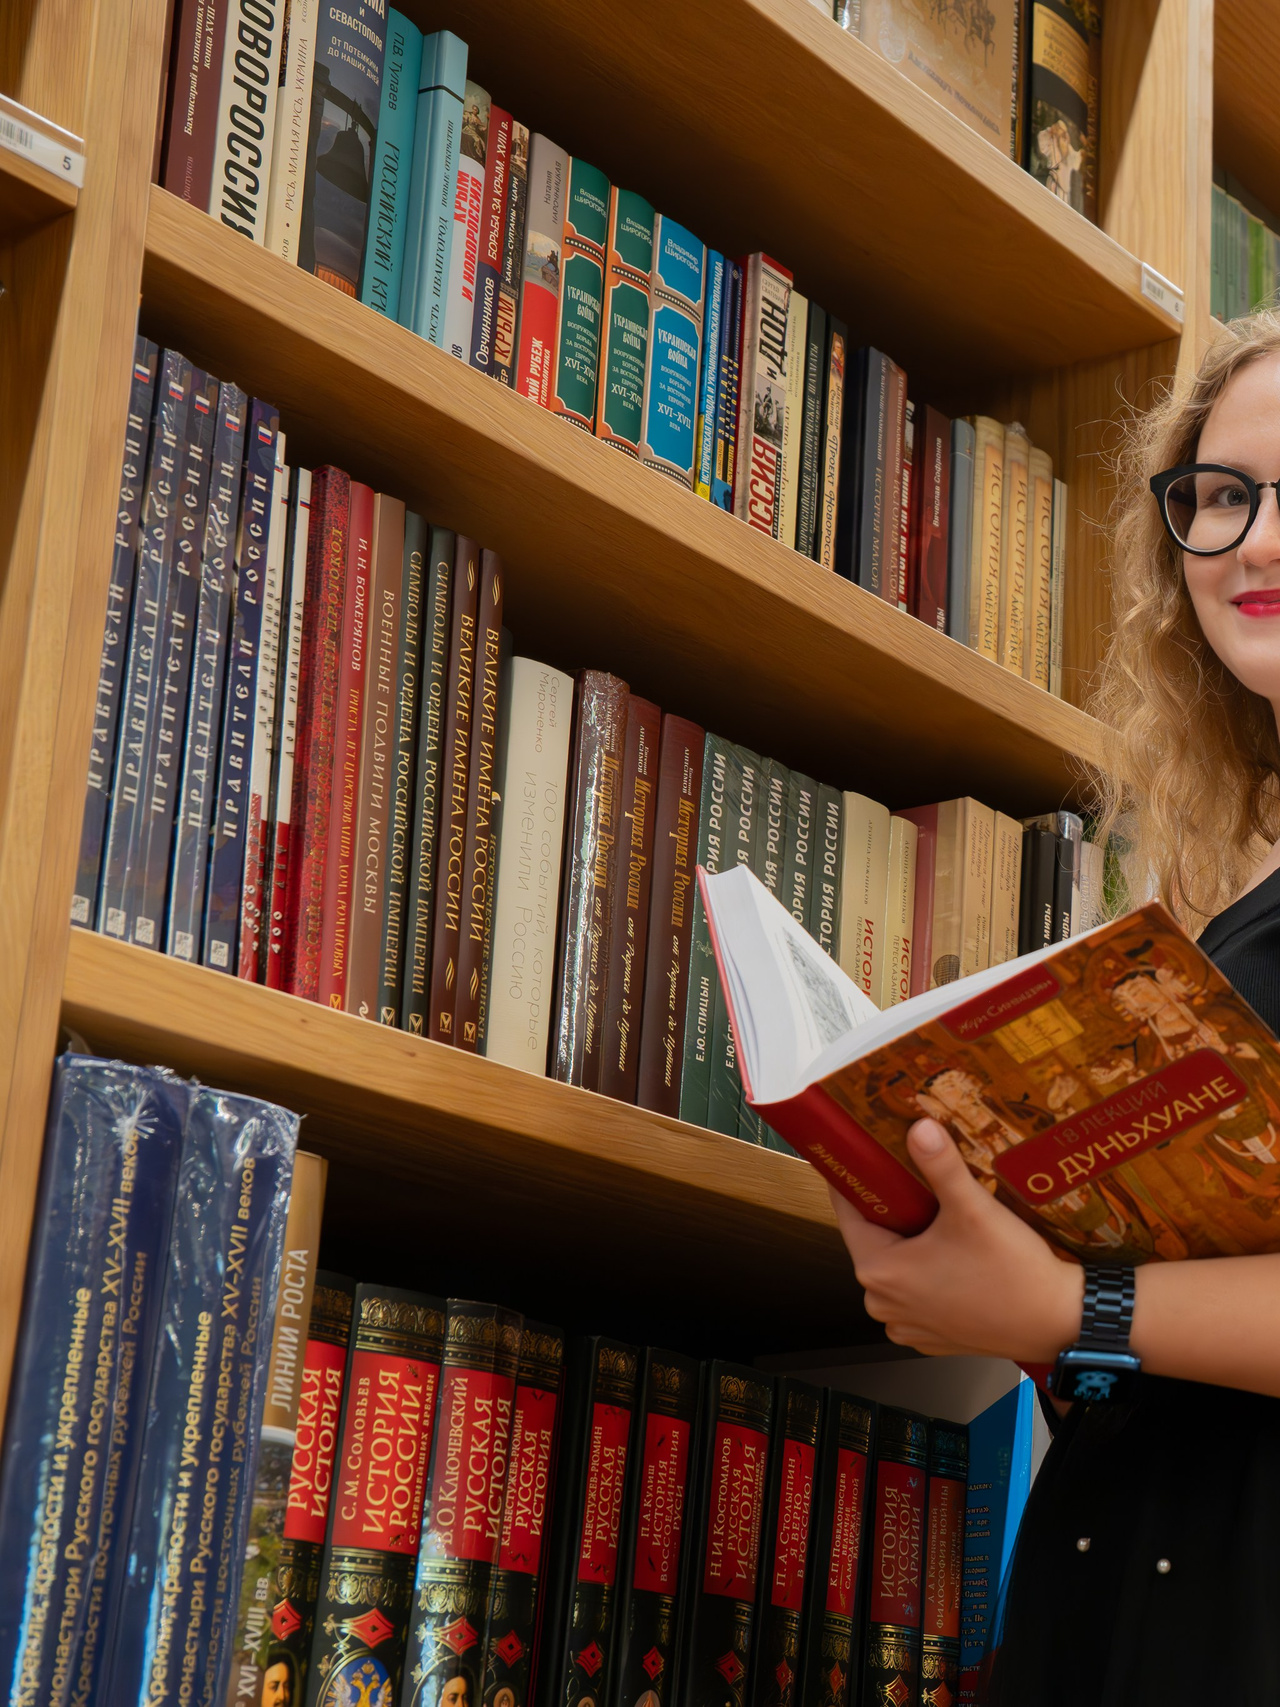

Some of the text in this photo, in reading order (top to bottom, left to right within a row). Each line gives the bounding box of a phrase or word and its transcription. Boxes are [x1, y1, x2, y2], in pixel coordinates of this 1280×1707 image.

[295, 38, 308, 91] УКРАИНА
[327, 46, 365, 75] ДО НАШИХ
[331, 36, 342, 47] ОТ
[184, 73, 199, 135] Бахчисарай
[221, 0, 277, 241] ОВОРОССИ
[62, 155, 72, 171] 5
[374, 141, 400, 272] РОССИЙСКИЙ
[454, 171, 470, 223] КРЫМ
[491, 198, 502, 215] ЗА
[462, 179, 483, 287] НОВОРОССИЯ
[488, 216, 501, 261] БОРЬБА
[507, 208, 518, 249] СУЛТАНЫ
[495, 296, 514, 359] КРЫМ
[530, 337, 543, 376] РУБЕЖ
[749, 436, 774, 533] ОССИЯ
[87, 413, 143, 789] ПРАВИТЕЛИ РОССИИ
[151, 443, 203, 813] ПРАВИТЕЛИ РОССИИ
[351, 576, 366, 671] БОЖЕРЯНОВ
[223, 473, 267, 838] ПРАВИТЕЛИ РОССИИ
[363, 589, 395, 915] ВОЕННЫЕ ПОДВИГИ МОСКВЫ
[383, 550, 422, 988] СИМВОЛЫ ОРДЕНА РОССИЙСКОЙ ИМПЕРИИ
[412, 560, 449, 994] СИМВОЛЫ ОРДЕНА РОССИЙСКОЙ ИМПЕРИИ
[444, 614, 474, 933] ВЕЛИКИЕ ИМЕНА РОССИИ
[470, 626, 499, 942] ВЕЛИКИЕ ИМЕНА РОССИИ
[709, 752, 727, 831] РОССИИ
[738, 765, 755, 844] РОССИИ
[625, 776, 651, 910] История России
[669, 797, 695, 928] История России
[766, 777, 783, 856] РОССИИ
[795, 790, 811, 866] РОССИИ
[824, 801, 839, 878] РОССИИ
[1027, 1075, 1237, 1194] О ДУНЬХУАНЕ
[1079, 1080, 1168, 1135] ЛЕКЦИЙ
[190, 1157, 256, 1574] Русского государства веков
[271, 1249, 309, 1412] ЛИНИИ РОСТА
[65, 1300, 118, 1561] Русского государства
[180, 1311, 213, 1467] укрепленные
[288, 1368, 321, 1511] РУССКАЯ
[311, 1368, 341, 1518] ИСТОРИЯ
[422, 1373, 436, 1427] ВРЕМЕН
[362, 1368, 400, 1533] ИСТОРИЯ
[389, 1382, 423, 1528] РОССИИ
[463, 1397, 493, 1532] РУССКАЯ
[485, 1397, 512, 1539] ИСТОРИЯ
[515, 1430, 538, 1528] РУССКАЯ
[530, 1429, 551, 1537] ИСТОРИЯ
[595, 1446, 617, 1542] РУССКАЯ
[608, 1446, 626, 1549] ИСТОРИЯ
[652, 1460, 668, 1547] ИСТОРИЯ
[660, 1430, 680, 1582] ВОССОЕДИНЕНИЯ
[673, 1485, 684, 1530] РУСИ
[727, 1468, 742, 1551] РУССКАЯ
[735, 1444, 757, 1580] ИСТОРИЯ
[790, 1492, 802, 1542] ВЕРЮ
[845, 1478, 860, 1590] САМОДЕРЖАВНОЙ
[880, 1485, 898, 1598] ИСТОРИЯ
[897, 1491, 911, 1598] РУССКОЙ
[910, 1506, 921, 1588] АРМИИ
[935, 1485, 949, 1629] ФИЛОСОФИЯ ВОЙНЫ
